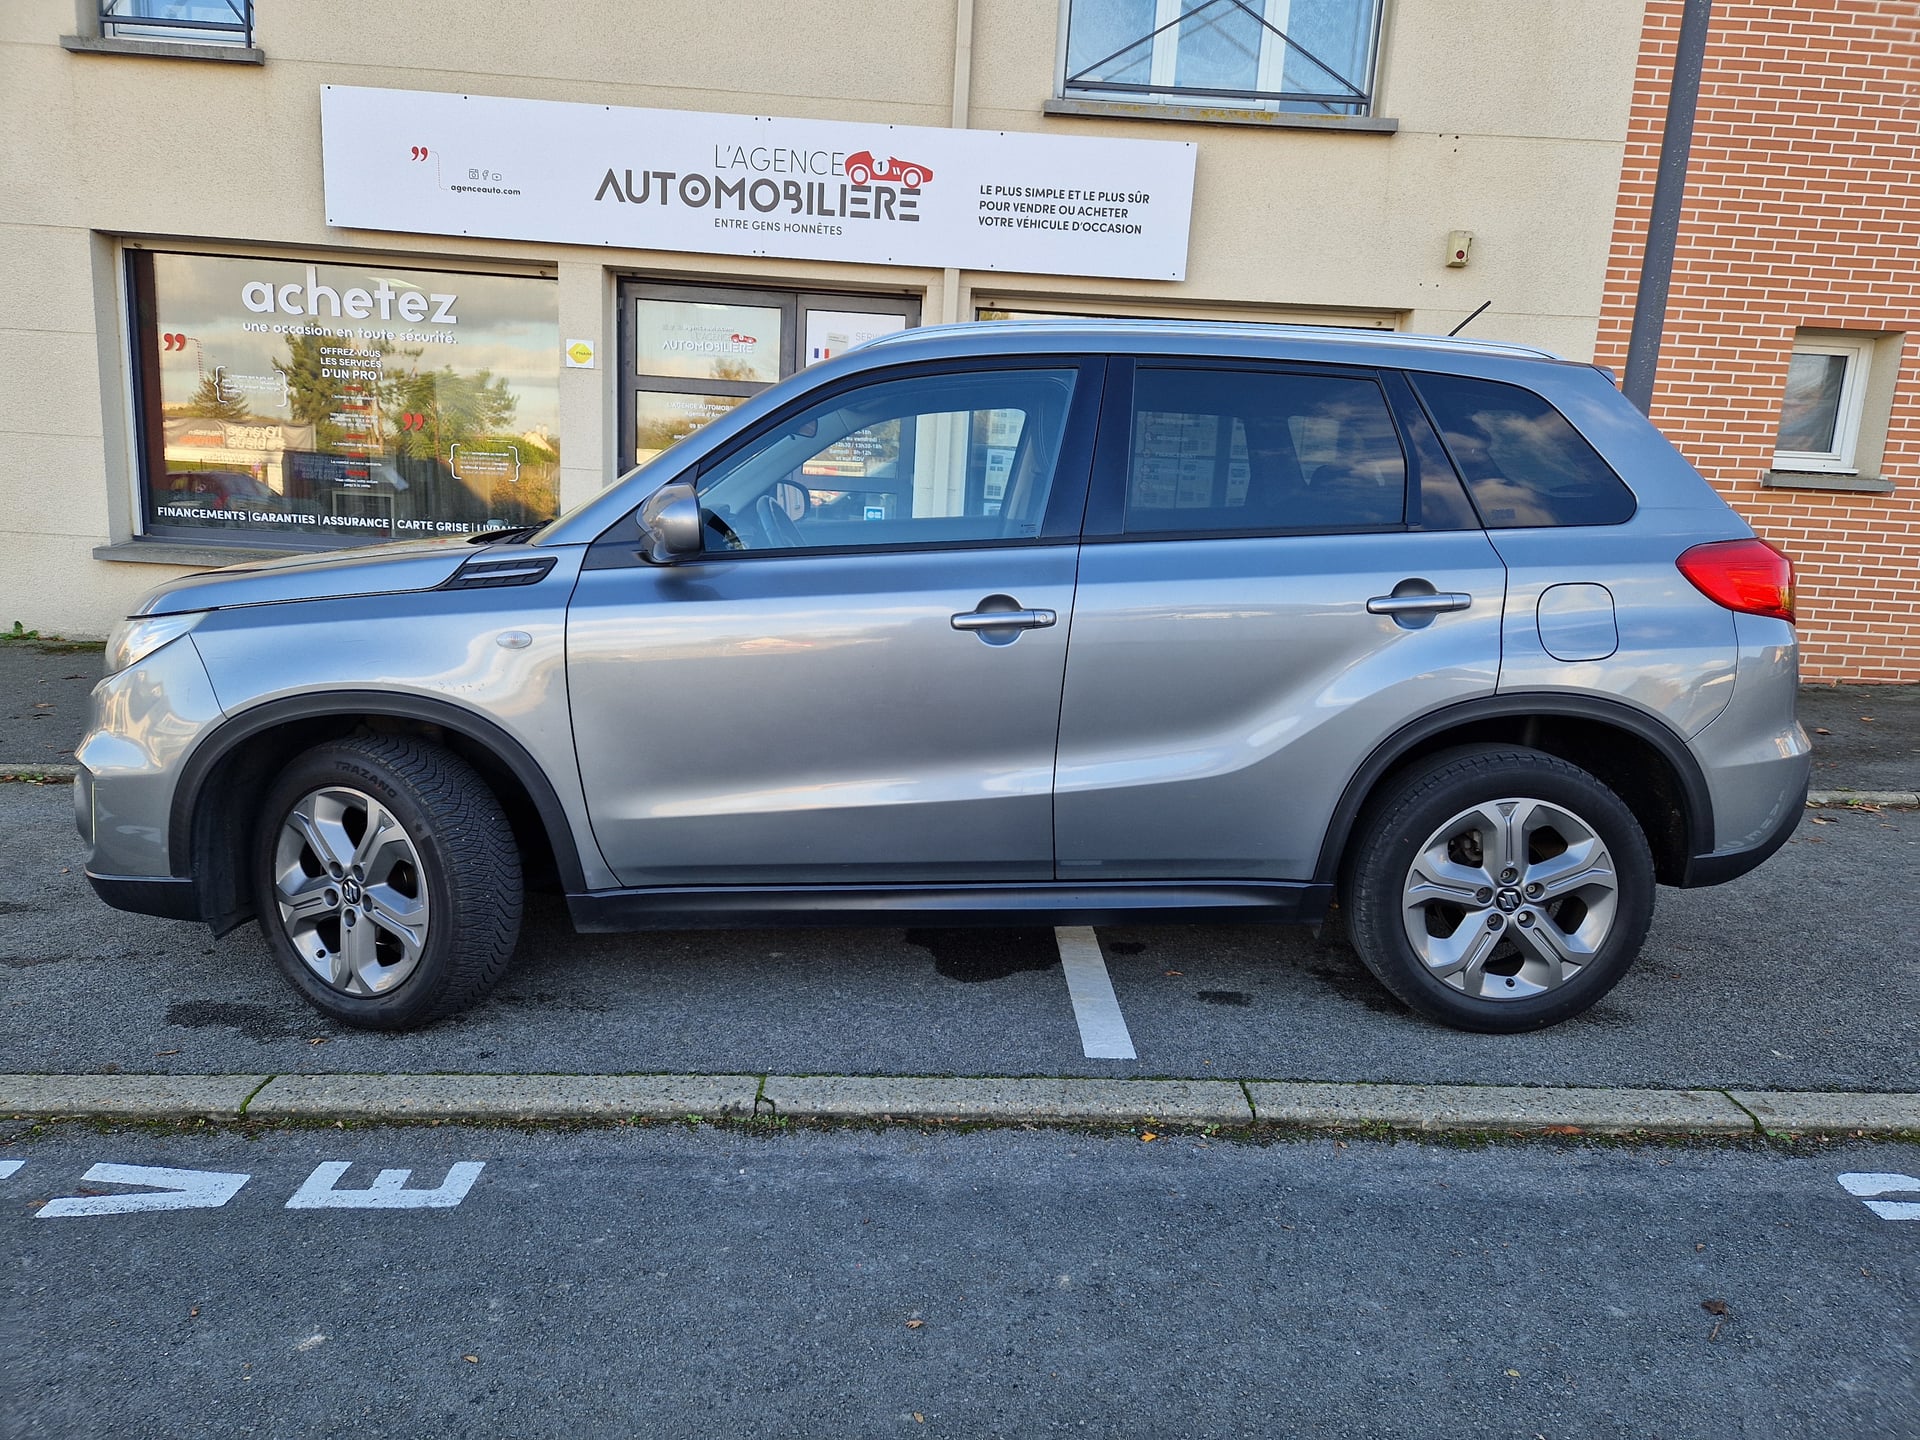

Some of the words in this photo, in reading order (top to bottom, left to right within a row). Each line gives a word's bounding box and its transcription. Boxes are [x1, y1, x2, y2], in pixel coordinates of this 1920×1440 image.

[715, 144, 845, 177] L'AGENCE
[450, 184, 521, 195] agenceauto.com
[594, 168, 921, 222] AUTOMOBILIERE
[980, 185, 992, 195] LE
[995, 185, 1022, 197] PLUS
[1025, 187, 1065, 199] SIMPLE
[1068, 190, 1081, 200] ET
[1083, 191, 1095, 201] LE
[1098, 192, 1125, 203] PLUS
[1128, 191, 1150, 204] SÛR
[979, 201, 1010, 212] POUR
[1013, 202, 1056, 214] VENDRE
[1058, 205, 1075, 216] OU
[1077, 206, 1128, 218] ACHETER
[714, 218, 749, 230] ENTRE
[752, 220, 781, 232] GENS
[783, 221, 843, 236] HONNÊTES
[978, 216, 1013, 228] VOTRE
[1016, 216, 1069, 231] VÉHICULE
[1072, 221, 1142, 235] D'OCCASION
[241, 265, 458, 324] achetez
[243, 322, 269, 333] une
[273, 323, 333, 338] occasion
[336, 328, 354, 338] en
[359, 328, 395, 341] toute
[400, 329, 458, 344] sécurité.
[320, 347, 381, 358] OFFREZ-VOUS
[320, 357, 337, 366] LES
[339, 359, 382, 368] SERVICES
[322, 368, 349, 379] D'UN
[352, 370, 377, 381] PRO
[157, 506, 246, 521] FINANCEMENTS
[252, 512, 316, 525] GARANTIES
[323, 515, 390, 528] ASSURANCE
[397, 519, 433, 531] CARTE
[436, 521, 469, 533] GRISE
[335, 761, 397, 798] TRAZANO
